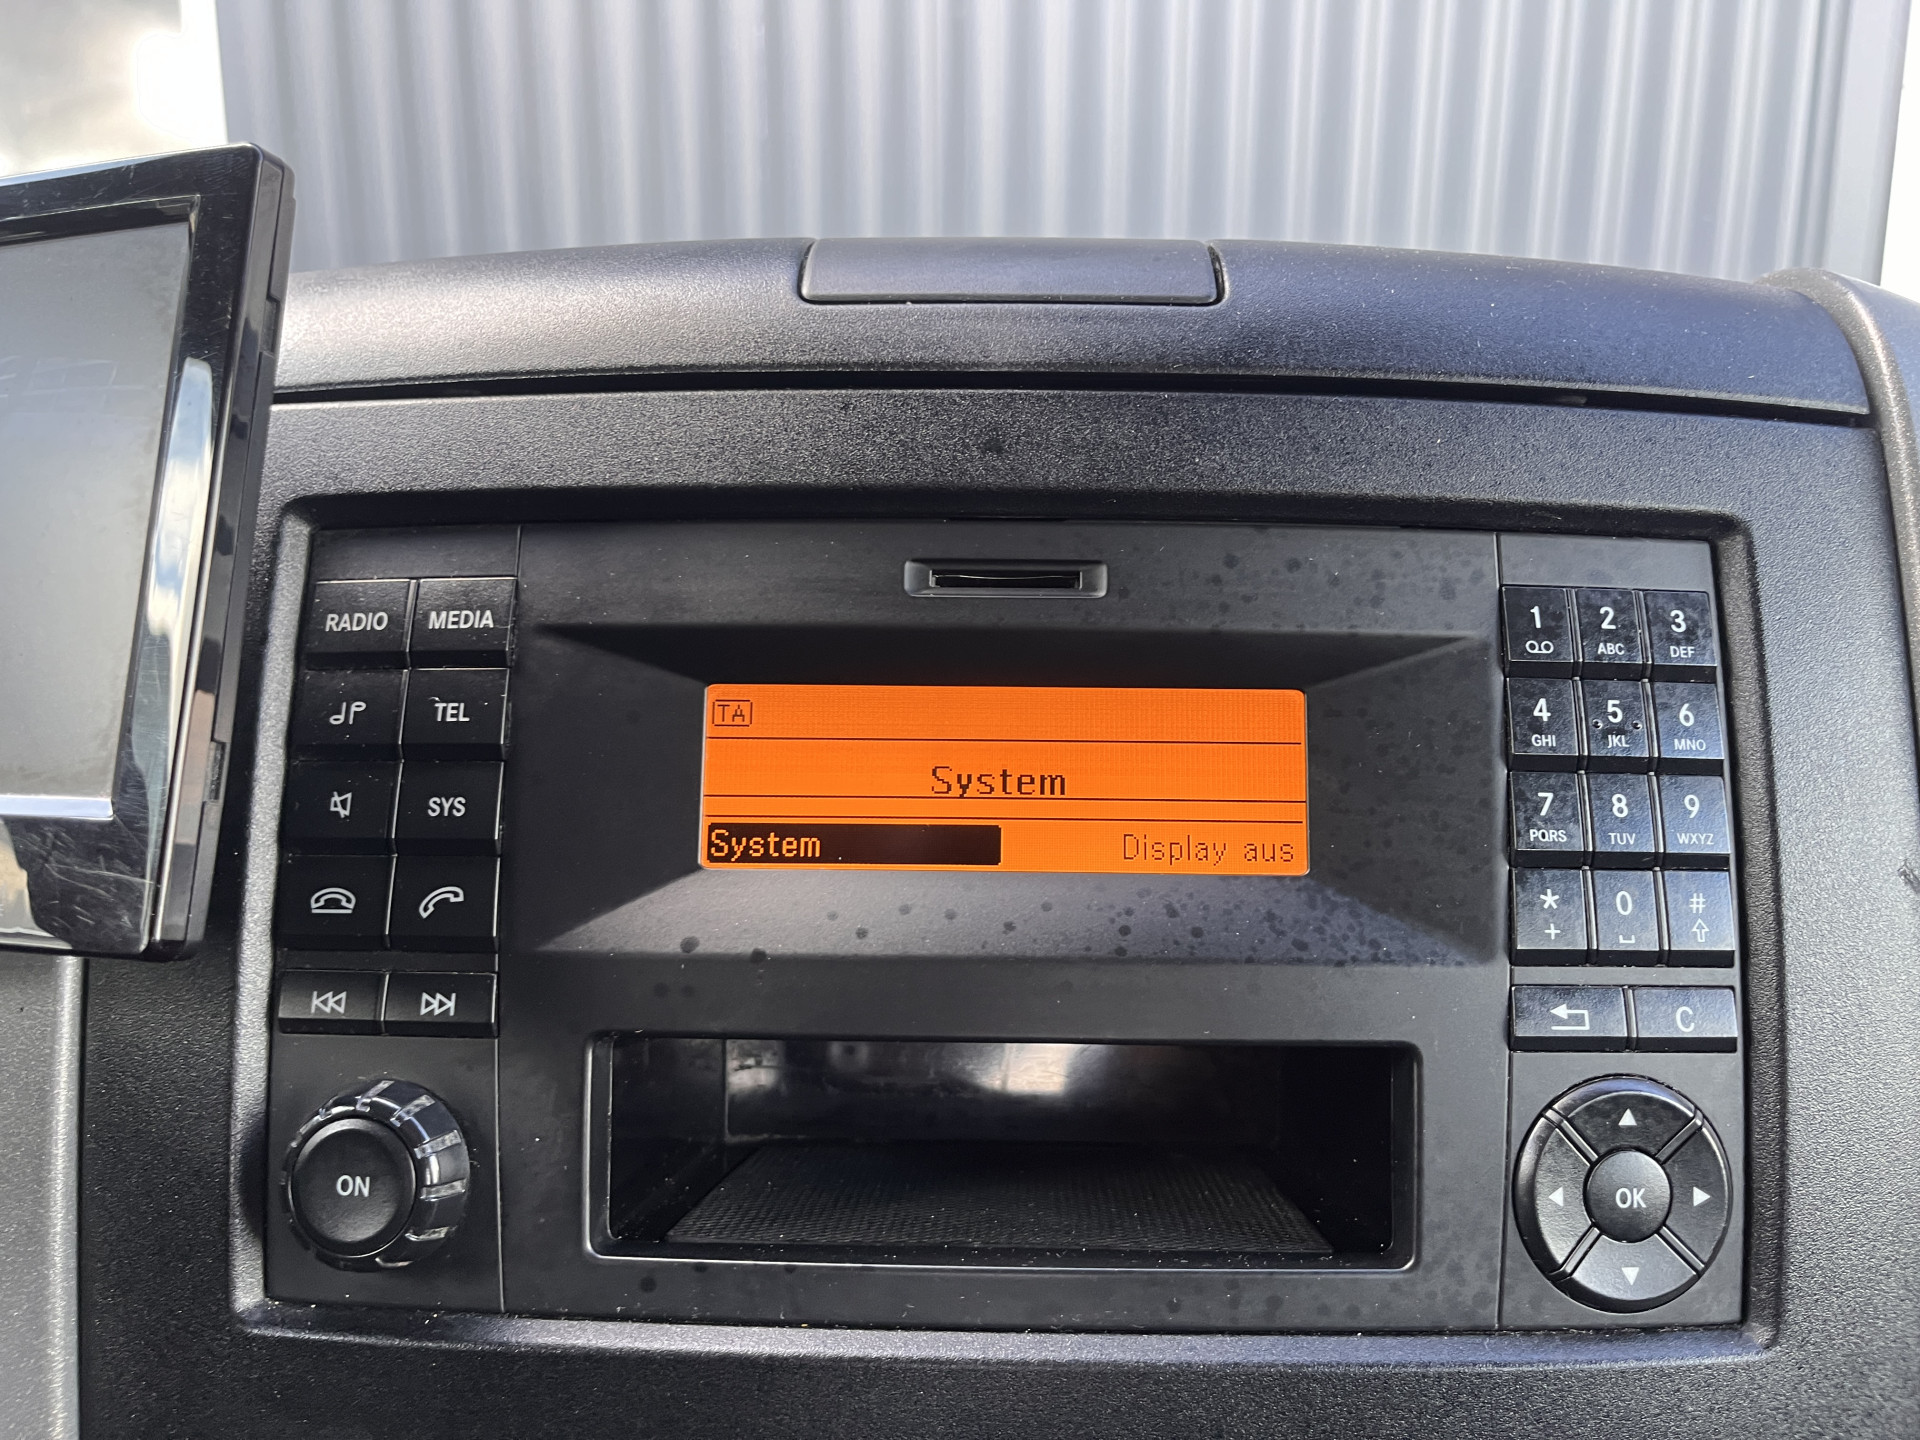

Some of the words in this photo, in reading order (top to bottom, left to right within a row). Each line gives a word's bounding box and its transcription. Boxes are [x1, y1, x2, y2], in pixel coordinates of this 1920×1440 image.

[324, 612, 389, 632] RADIO
[428, 610, 495, 630] MEDIA
[1529, 605, 1542, 629] 1
[1600, 606, 1617, 630] 2
[1669, 609, 1687, 633] 3
[1597, 643, 1626, 656] ABC
[1669, 646, 1696, 659] DEF
[434, 702, 470, 722] TEL
[715, 703, 747, 724] TA
[1533, 697, 1552, 722] 4
[1606, 700, 1624, 723] 5
[1678, 703, 1696, 727] 6
[1531, 734, 1557, 748] GHI
[1606, 735, 1630, 749] JKL
[1673, 738, 1707, 752] MNO
[931, 765, 1067, 798] System
[427, 797, 466, 817] SYS
[1537, 792, 1554, 816] 7
[1611, 793, 1629, 818] 8
[1683, 794, 1700, 818] 9
[710, 829, 822, 861] System
[1529, 829, 1568, 843] PQRS
[1608, 832, 1637, 846] TUV
[1676, 832, 1715, 846] WXYZ
[1122, 834, 1227, 866] Display
[1243, 839, 1295, 863] aus
[1675, 1006, 1696, 1033] C
[335, 1174, 371, 1198] ON
[1615, 1187, 1647, 1209] OK
